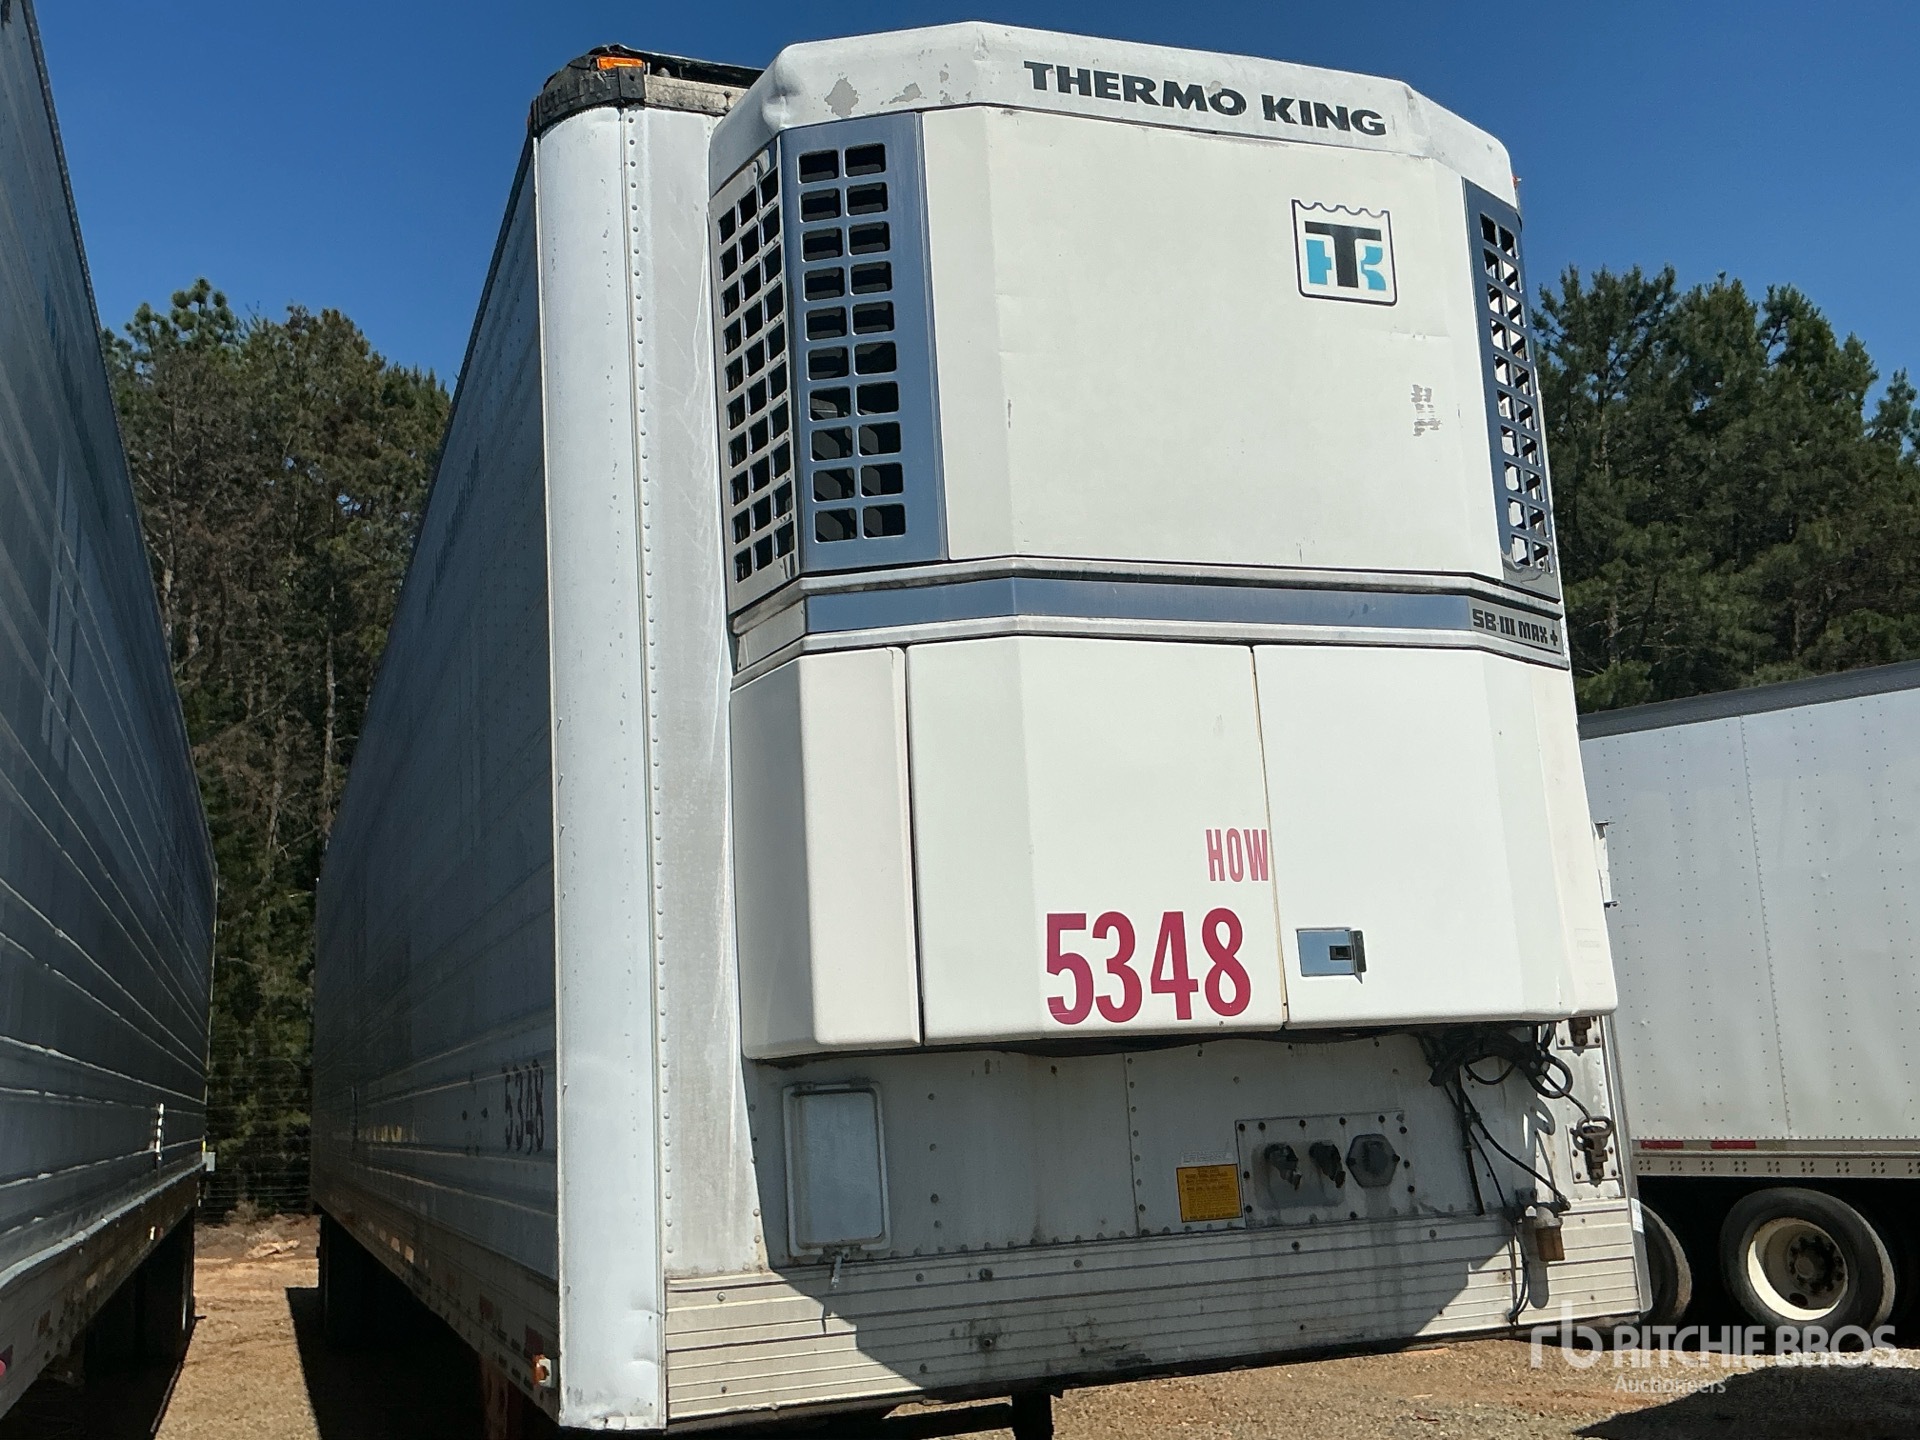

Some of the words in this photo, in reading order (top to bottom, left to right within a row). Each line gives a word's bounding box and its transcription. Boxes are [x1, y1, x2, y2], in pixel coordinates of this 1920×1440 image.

[1023, 60, 1246, 116] THERMO
[1261, 94, 1387, 136] KING
[1206, 828, 1268, 882] HOW
[1046, 907, 1251, 1025] 5348
[501, 1059, 545, 1156] 5348
